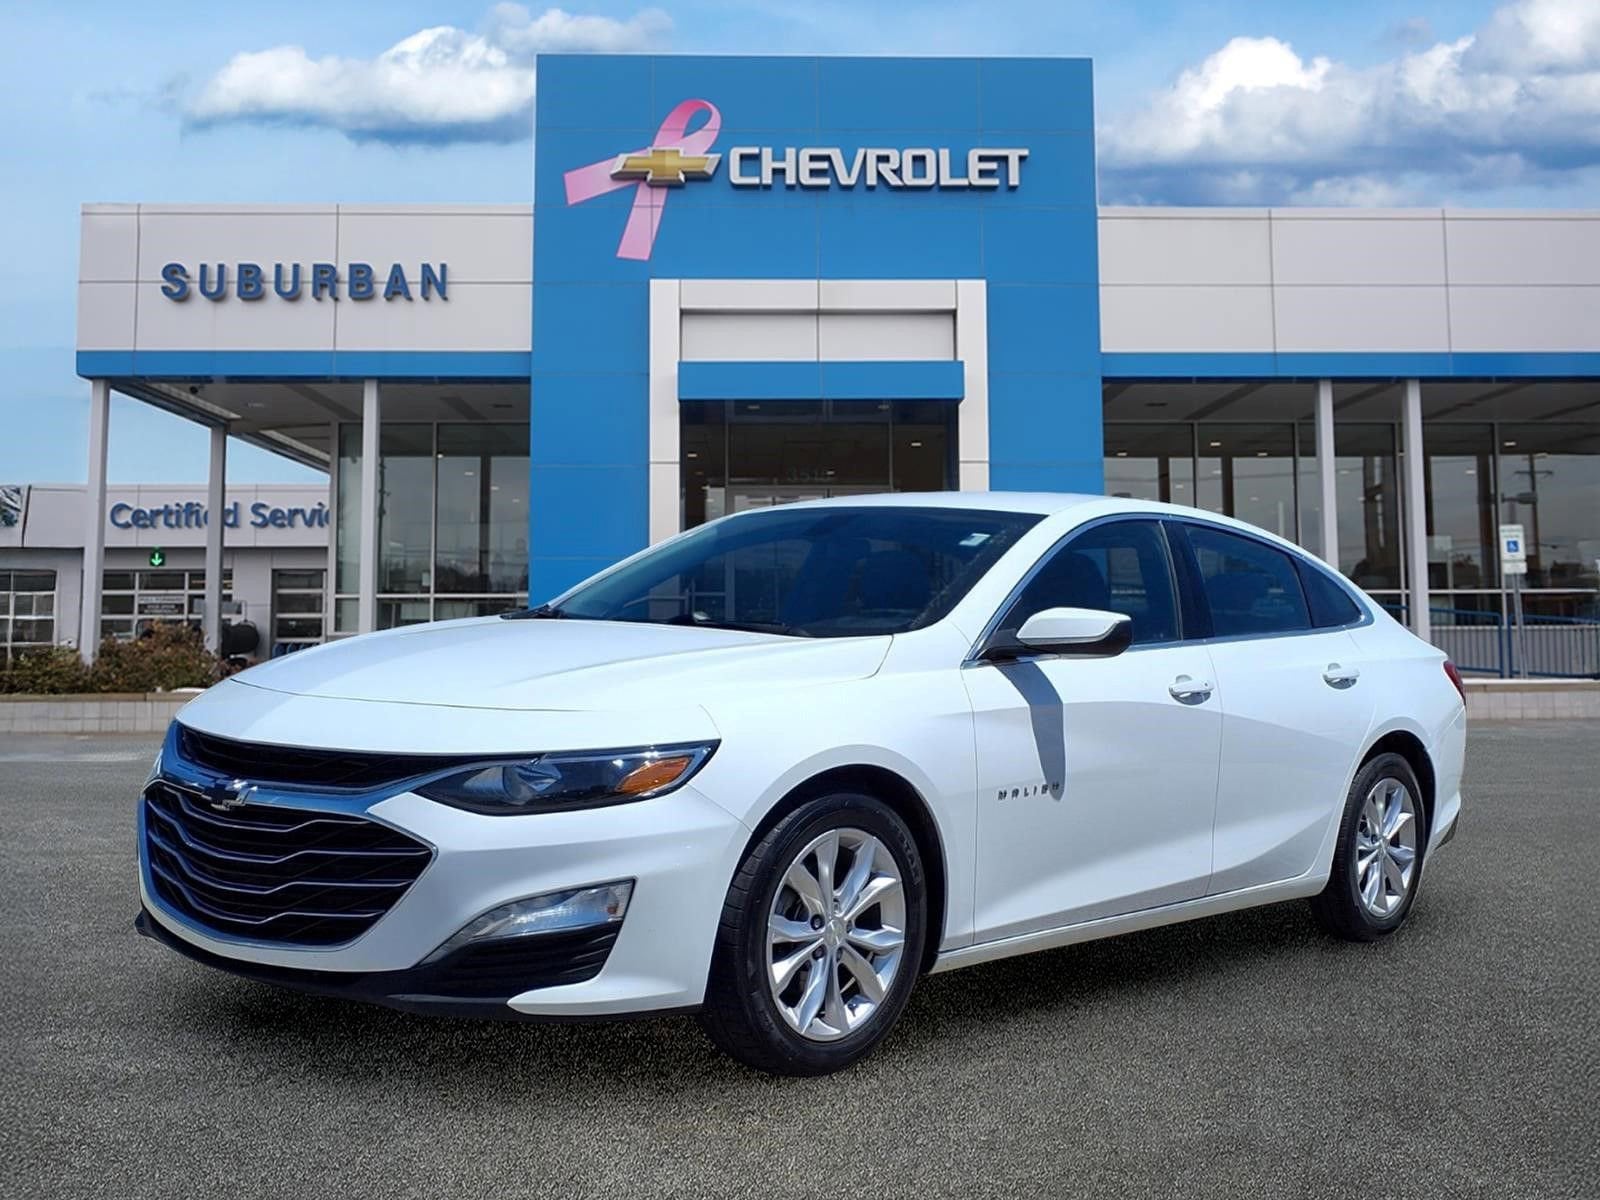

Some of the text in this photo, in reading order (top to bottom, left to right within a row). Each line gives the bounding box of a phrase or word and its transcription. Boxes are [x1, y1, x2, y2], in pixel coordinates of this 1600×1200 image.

[728, 146, 1029, 187] CHEVROLET
[160, 262, 449, 301] SUBURBAN
[110, 502, 240, 528] Certifid
